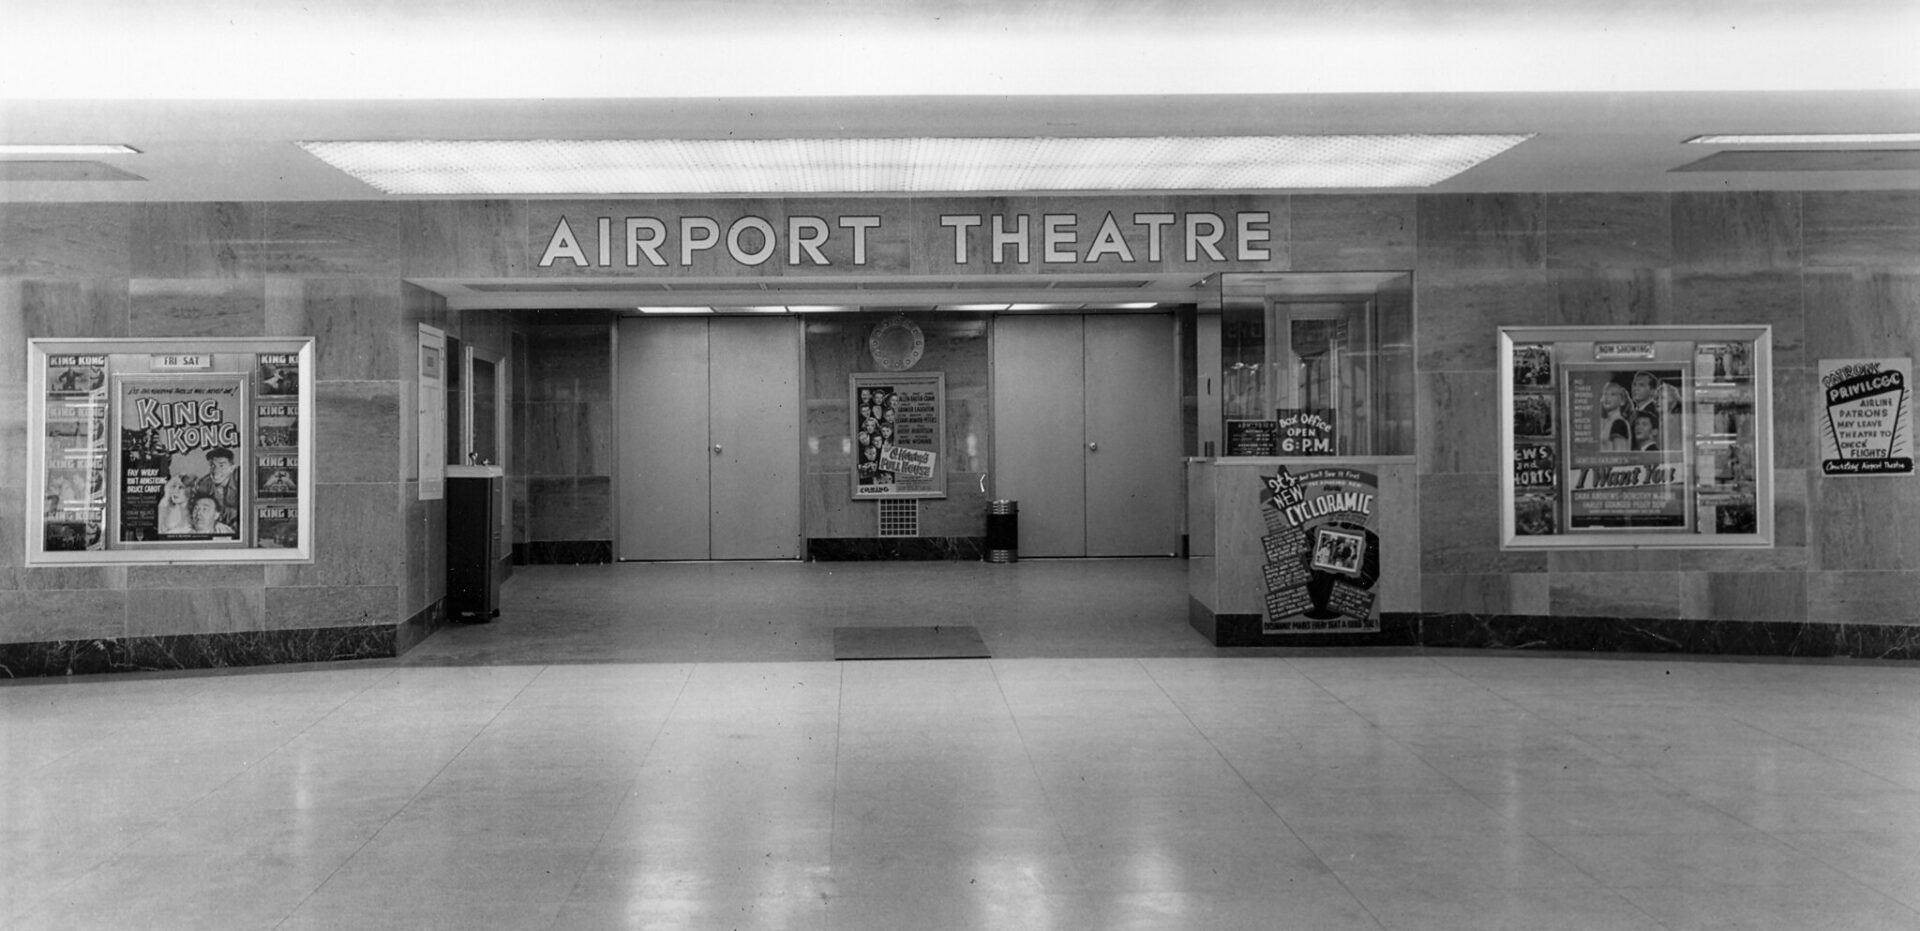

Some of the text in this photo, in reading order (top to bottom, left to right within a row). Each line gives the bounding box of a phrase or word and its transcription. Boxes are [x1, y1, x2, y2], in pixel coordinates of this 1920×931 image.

[537, 210, 1271, 267] AIRPORT THEATRE
[1600, 344, 1651, 354] NOW SHOWING
[51, 356, 104, 366] KING KONG
[164, 356, 200, 366] FRI SAT
[261, 354, 286, 364] KING
[1860, 398, 1893, 407] AIRLINE
[136, 397, 223, 430] KING
[260, 406, 285, 416] KING
[1839, 409, 1888, 418] PATRONS
[1857, 420, 1882, 428] LEAVE
[1287, 428, 1317, 437] OPEN
[1840, 430, 1892, 438] THEATRE TO
[167, 422, 240, 456] KONG
[1841, 439, 1868, 449] CHECK
[1514, 446, 1548, 461] EWS
[1851, 448, 1887, 457] FLIGHTS
[259, 457, 283, 467] KING
[1516, 460, 1538, 470] and
[1862, 461, 1882, 470] Airport
[1884, 461, 1905, 469] Theatre
[1514, 470, 1552, 485] HORTS
[1576, 467, 1589, 489] I
[1592, 466, 1642, 488] Want
[1273, 483, 1304, 509] NEW
[259, 508, 285, 518] KING
[1285, 491, 1374, 526] CYCLORAMIC
